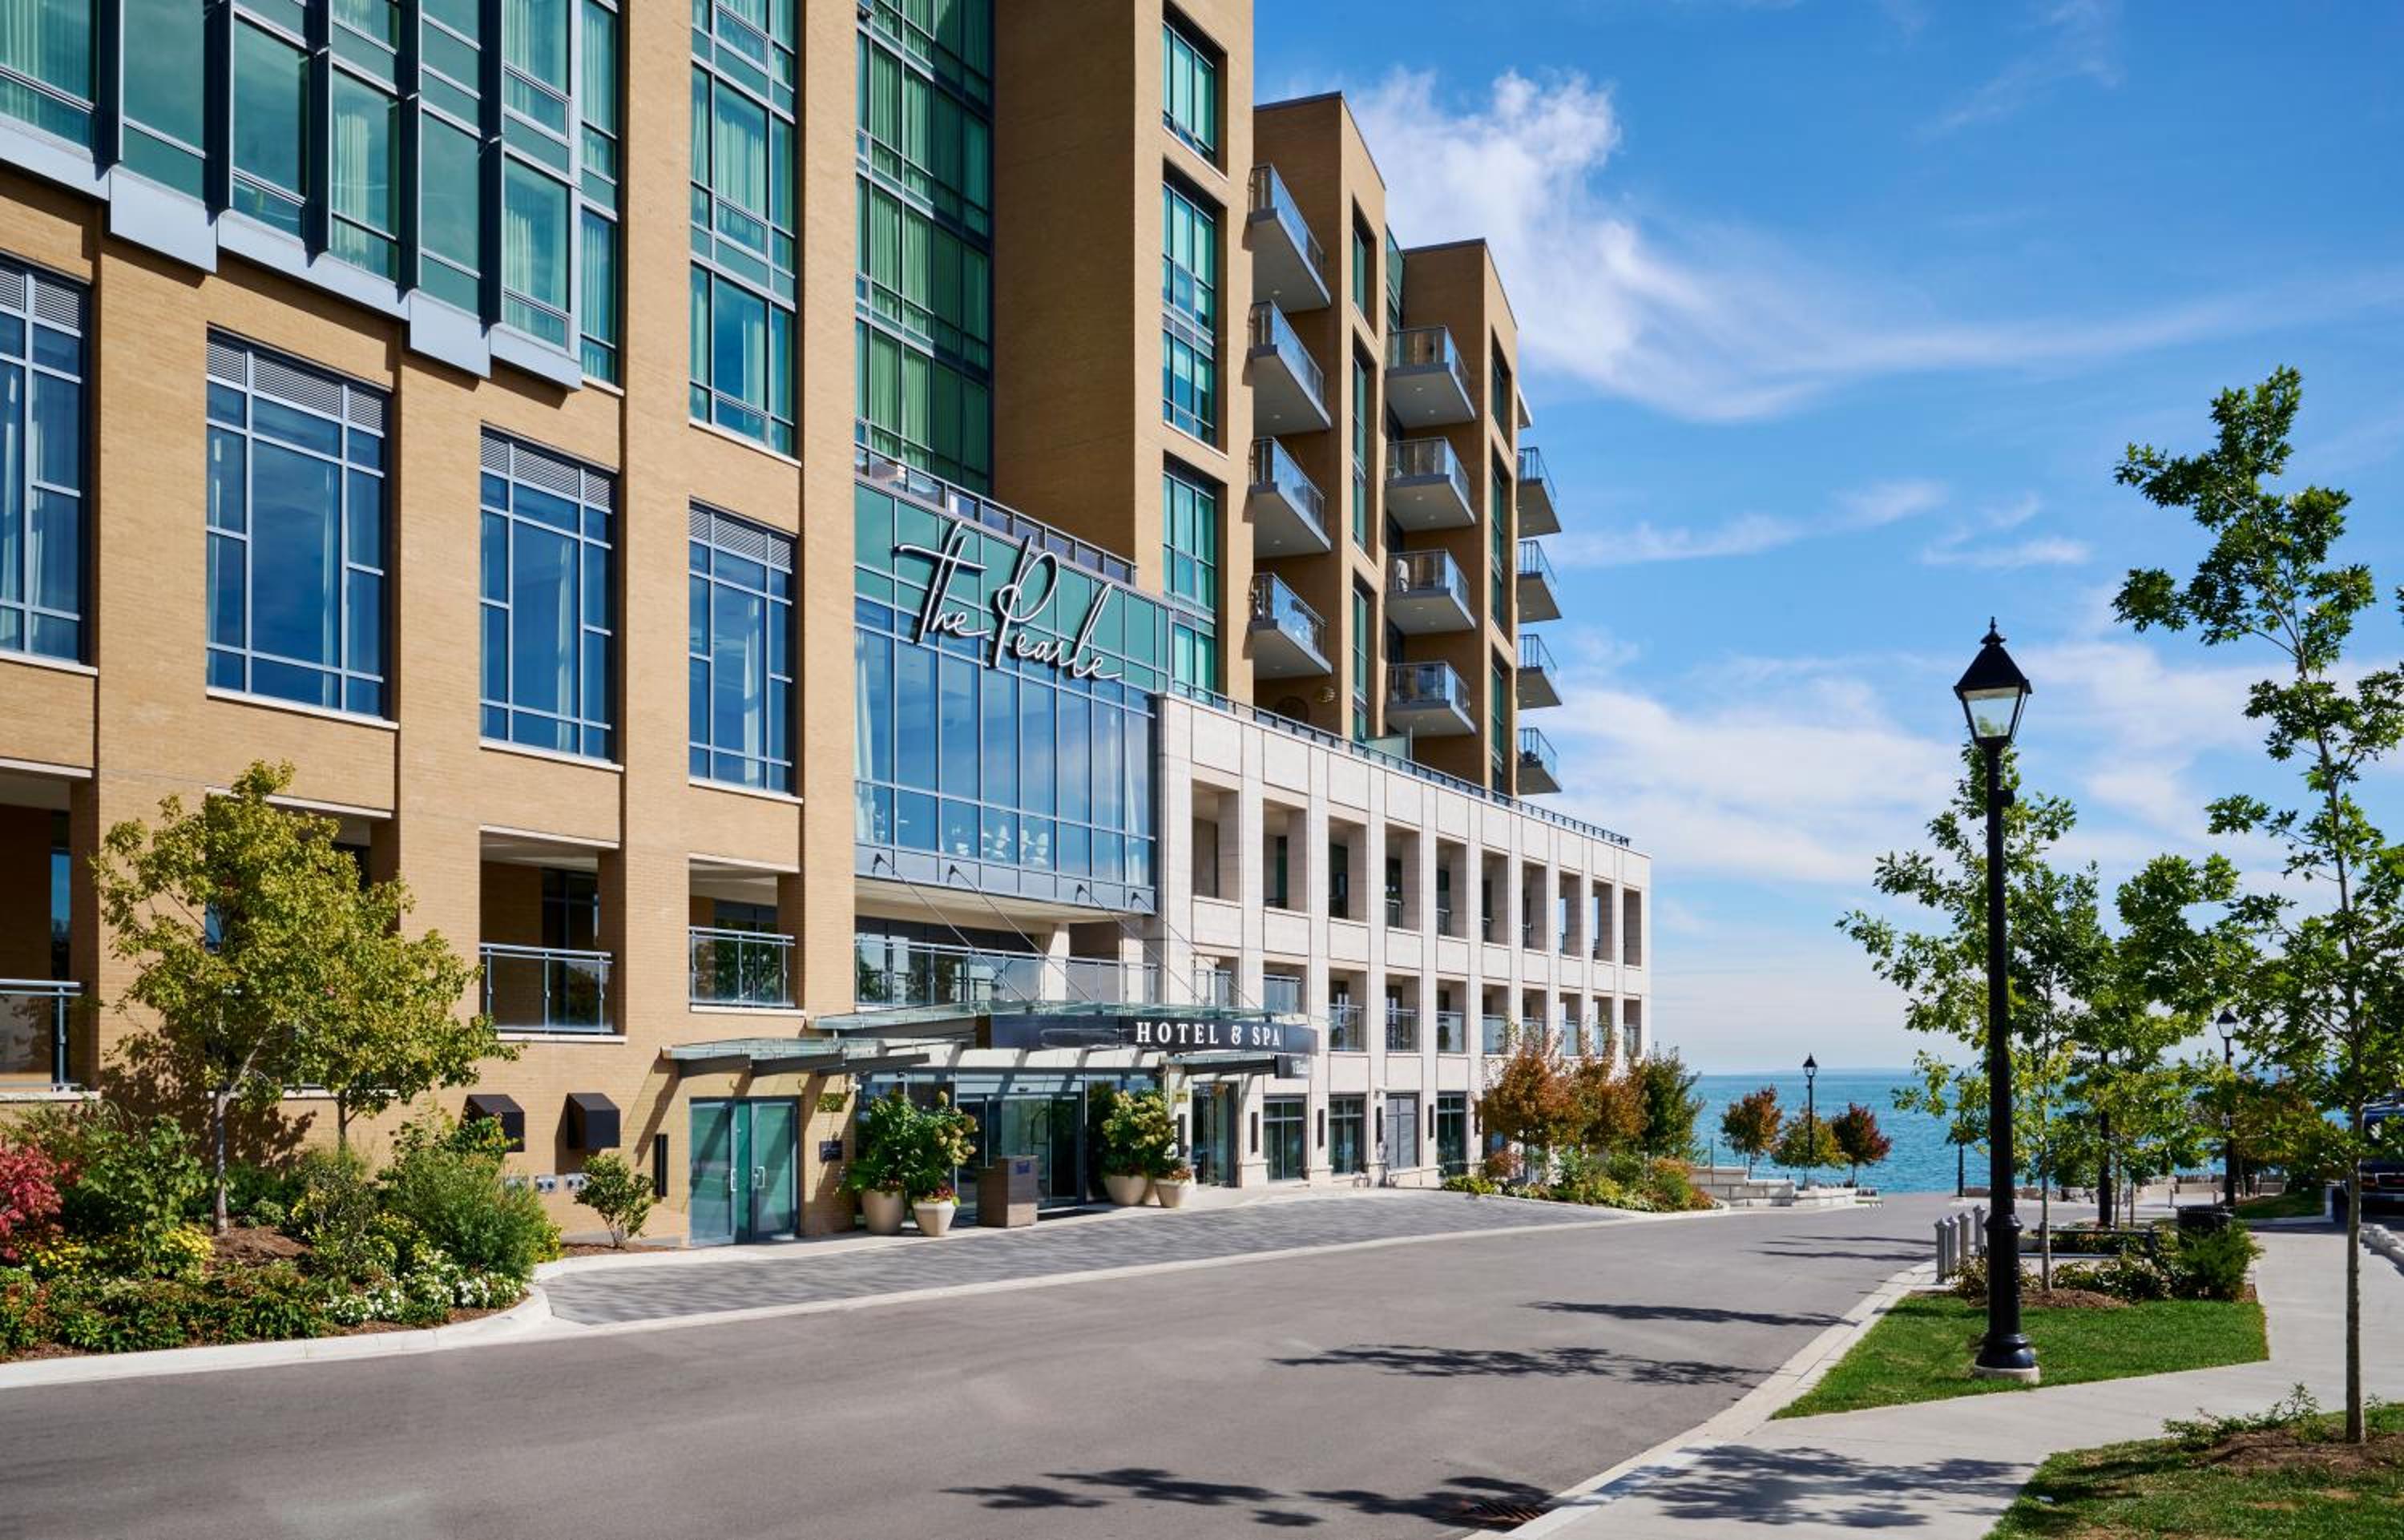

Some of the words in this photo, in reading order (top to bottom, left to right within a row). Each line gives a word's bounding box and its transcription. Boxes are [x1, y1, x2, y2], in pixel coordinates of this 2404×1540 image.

[993, 535, 1122, 679] Pearle
[1135, 1022, 1219, 1045] HOTEL
[1231, 1025, 1242, 1046] &
[1252, 1026, 1281, 1046] SPA
